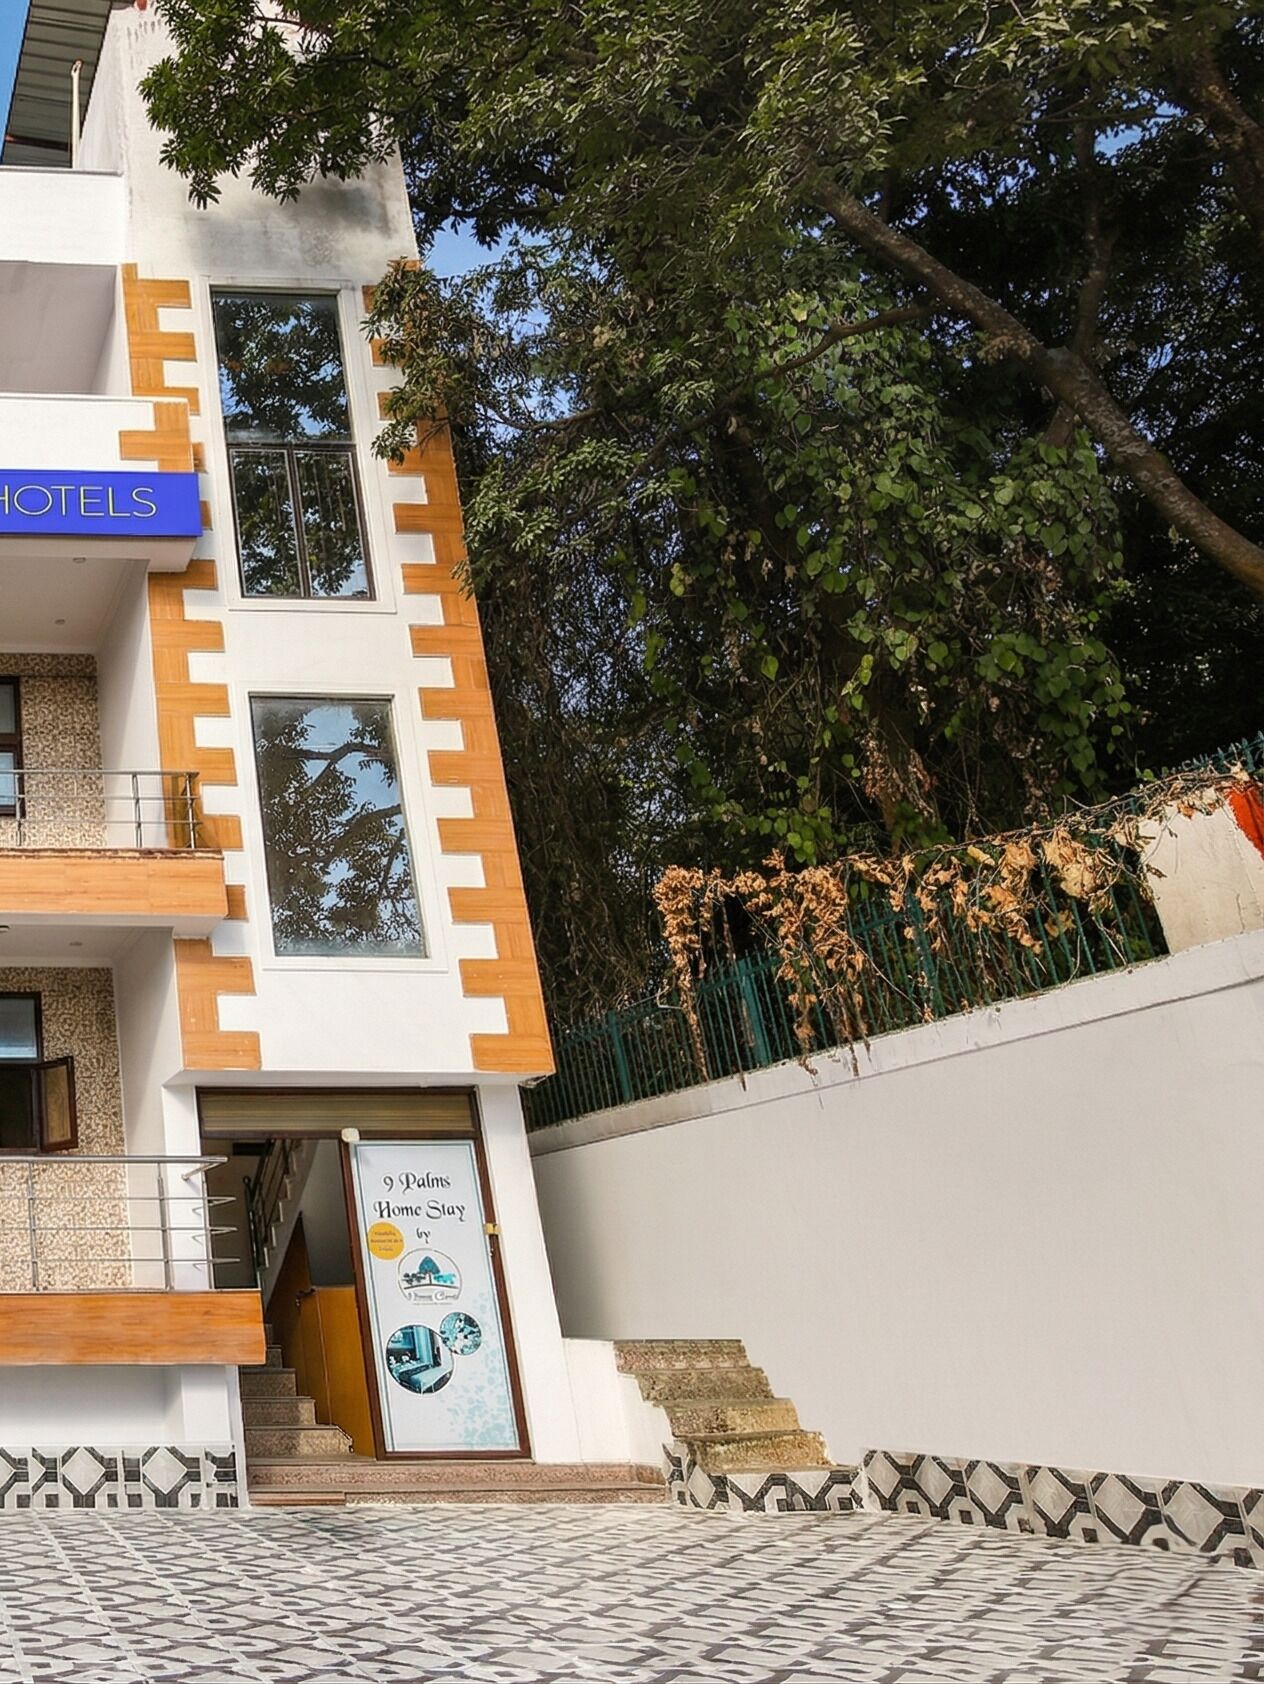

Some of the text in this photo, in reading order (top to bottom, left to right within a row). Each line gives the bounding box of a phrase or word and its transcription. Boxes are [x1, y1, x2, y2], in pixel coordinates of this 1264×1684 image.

[383, 1171, 451, 1195] 9 Palms
[373, 1199, 466, 1222] Home Stay
[416, 1227, 431, 1244] by
